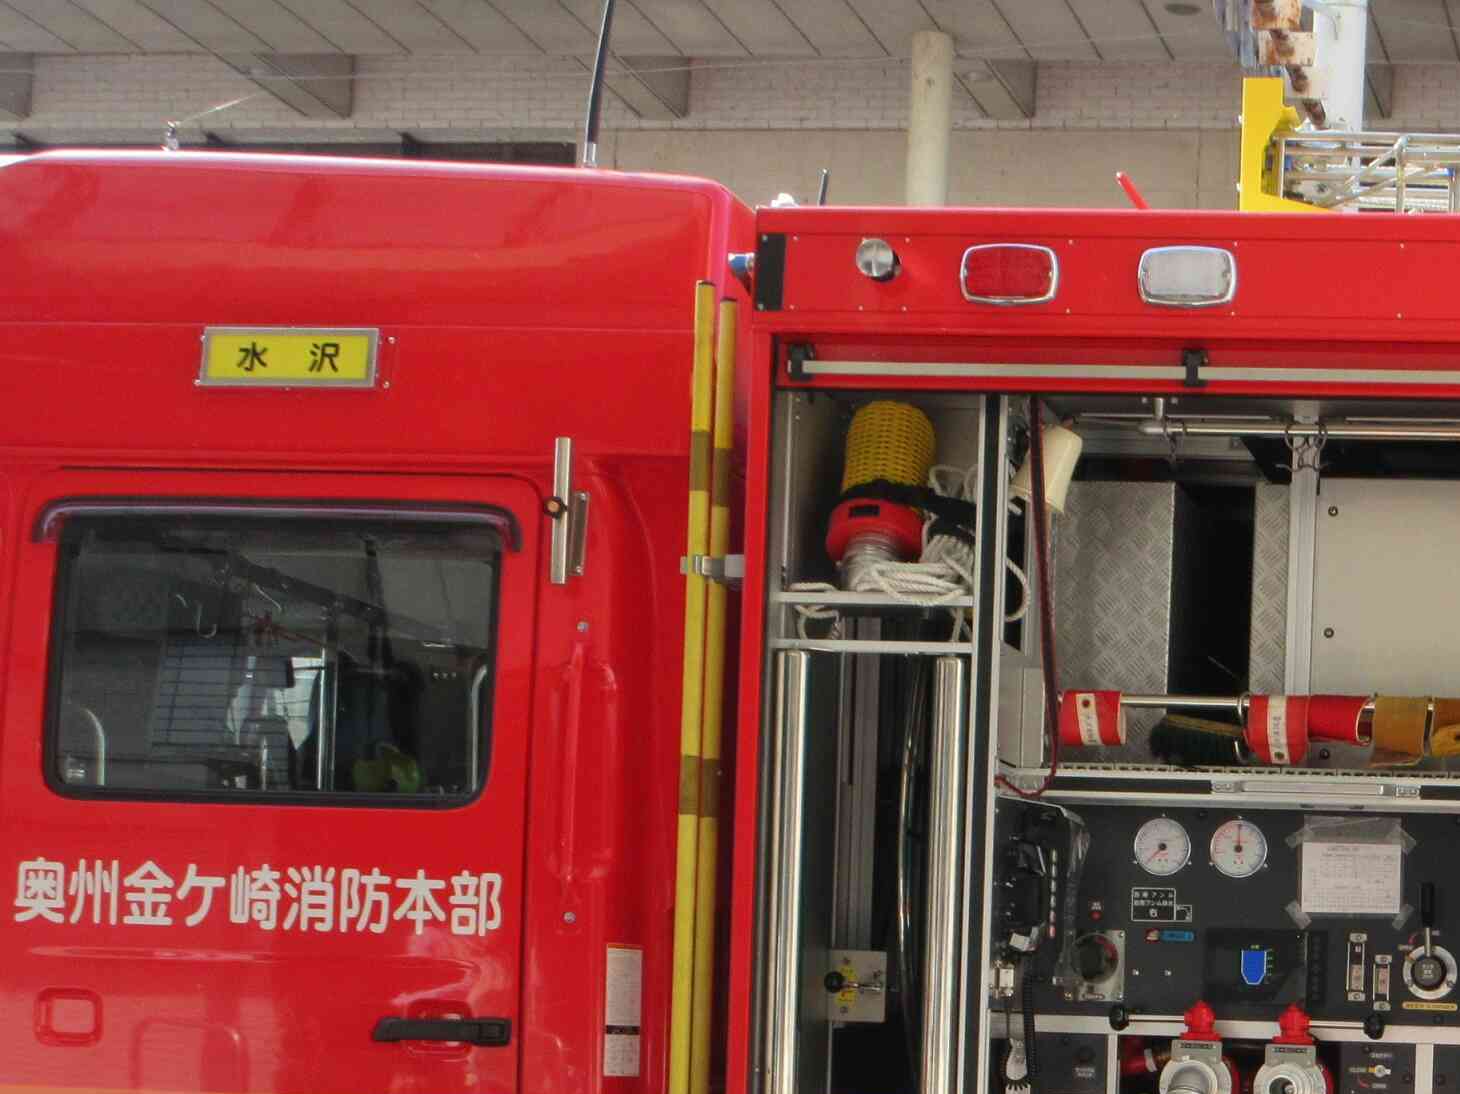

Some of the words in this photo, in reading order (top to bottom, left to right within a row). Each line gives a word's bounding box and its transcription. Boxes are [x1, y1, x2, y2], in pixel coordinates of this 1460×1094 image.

[236, 342, 340, 373] 水沢
[13, 856, 503, 937] 奥州金ケ崎消防本部
